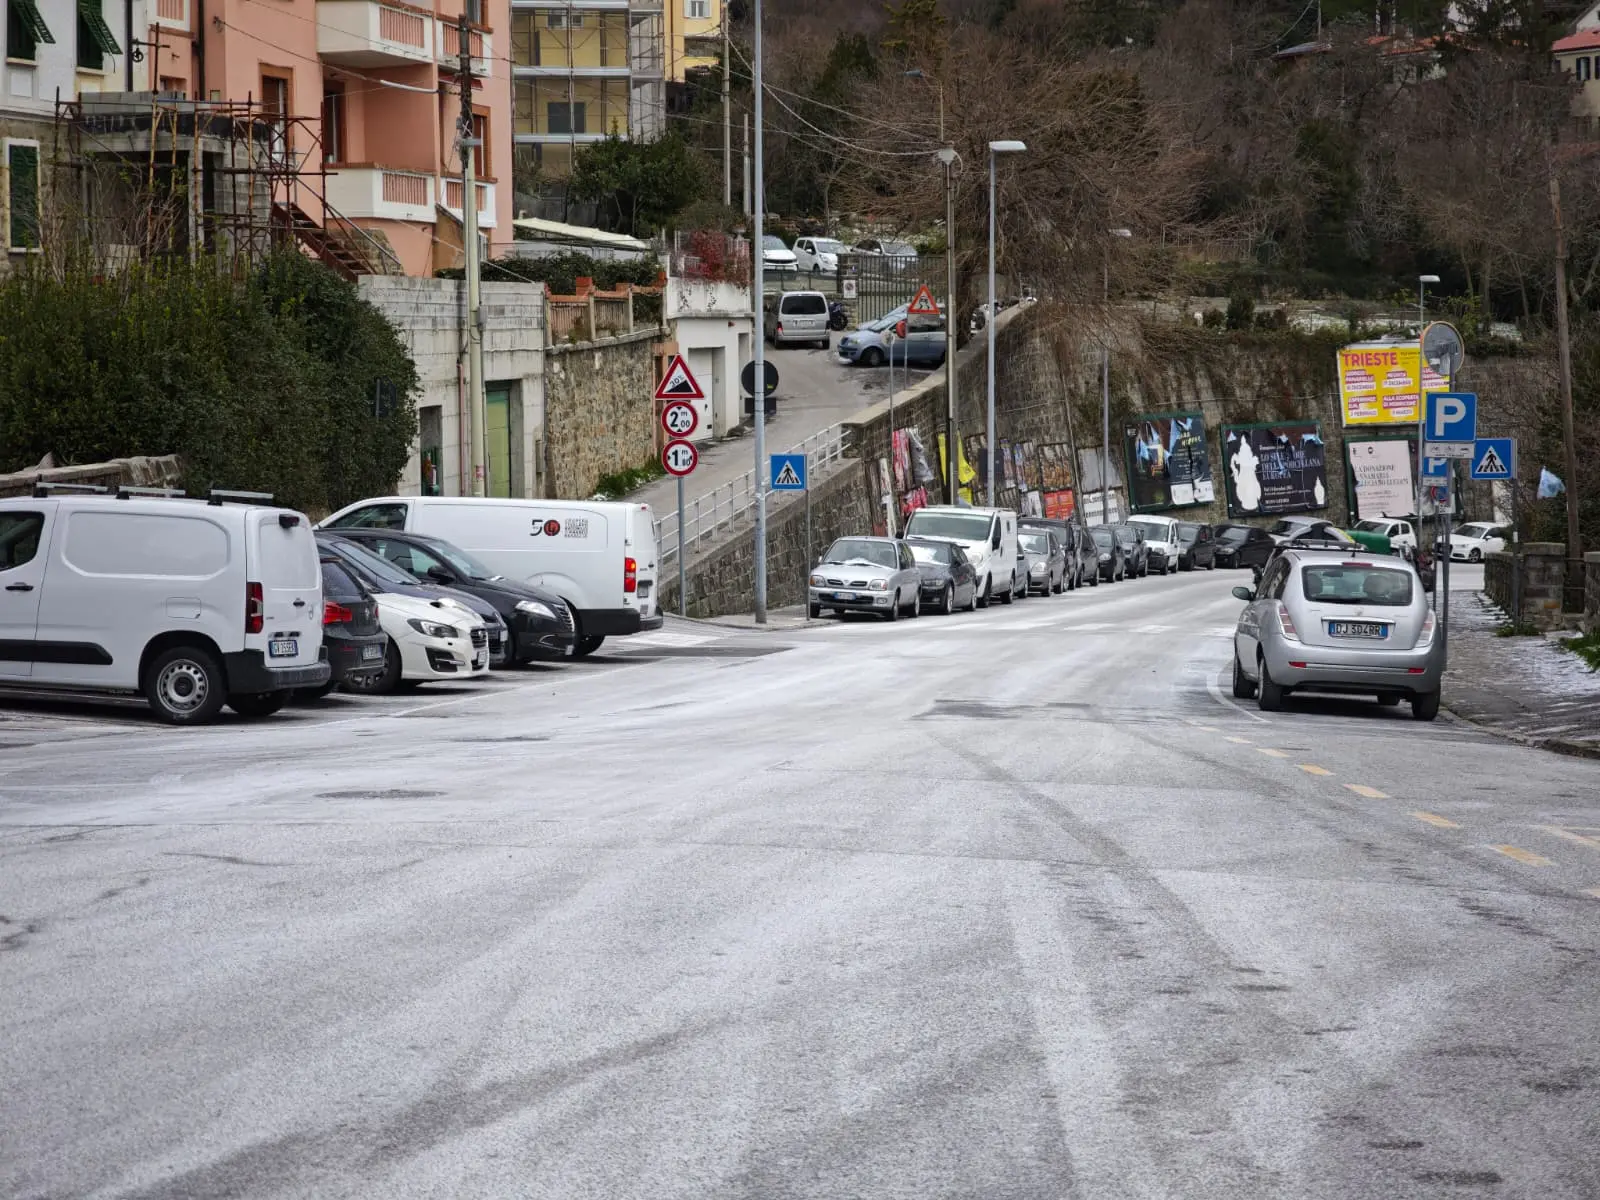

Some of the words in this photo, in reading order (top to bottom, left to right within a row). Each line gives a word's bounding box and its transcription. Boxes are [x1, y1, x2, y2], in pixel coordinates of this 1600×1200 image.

[1343, 352, 1398, 367] TRIESTE
[670, 411, 678, 427] 2
[680, 420, 690, 428] 00
[1434, 397, 1466, 436] P
[672, 449, 678, 466] 1
[1336, 624, 1348, 634] DJ
